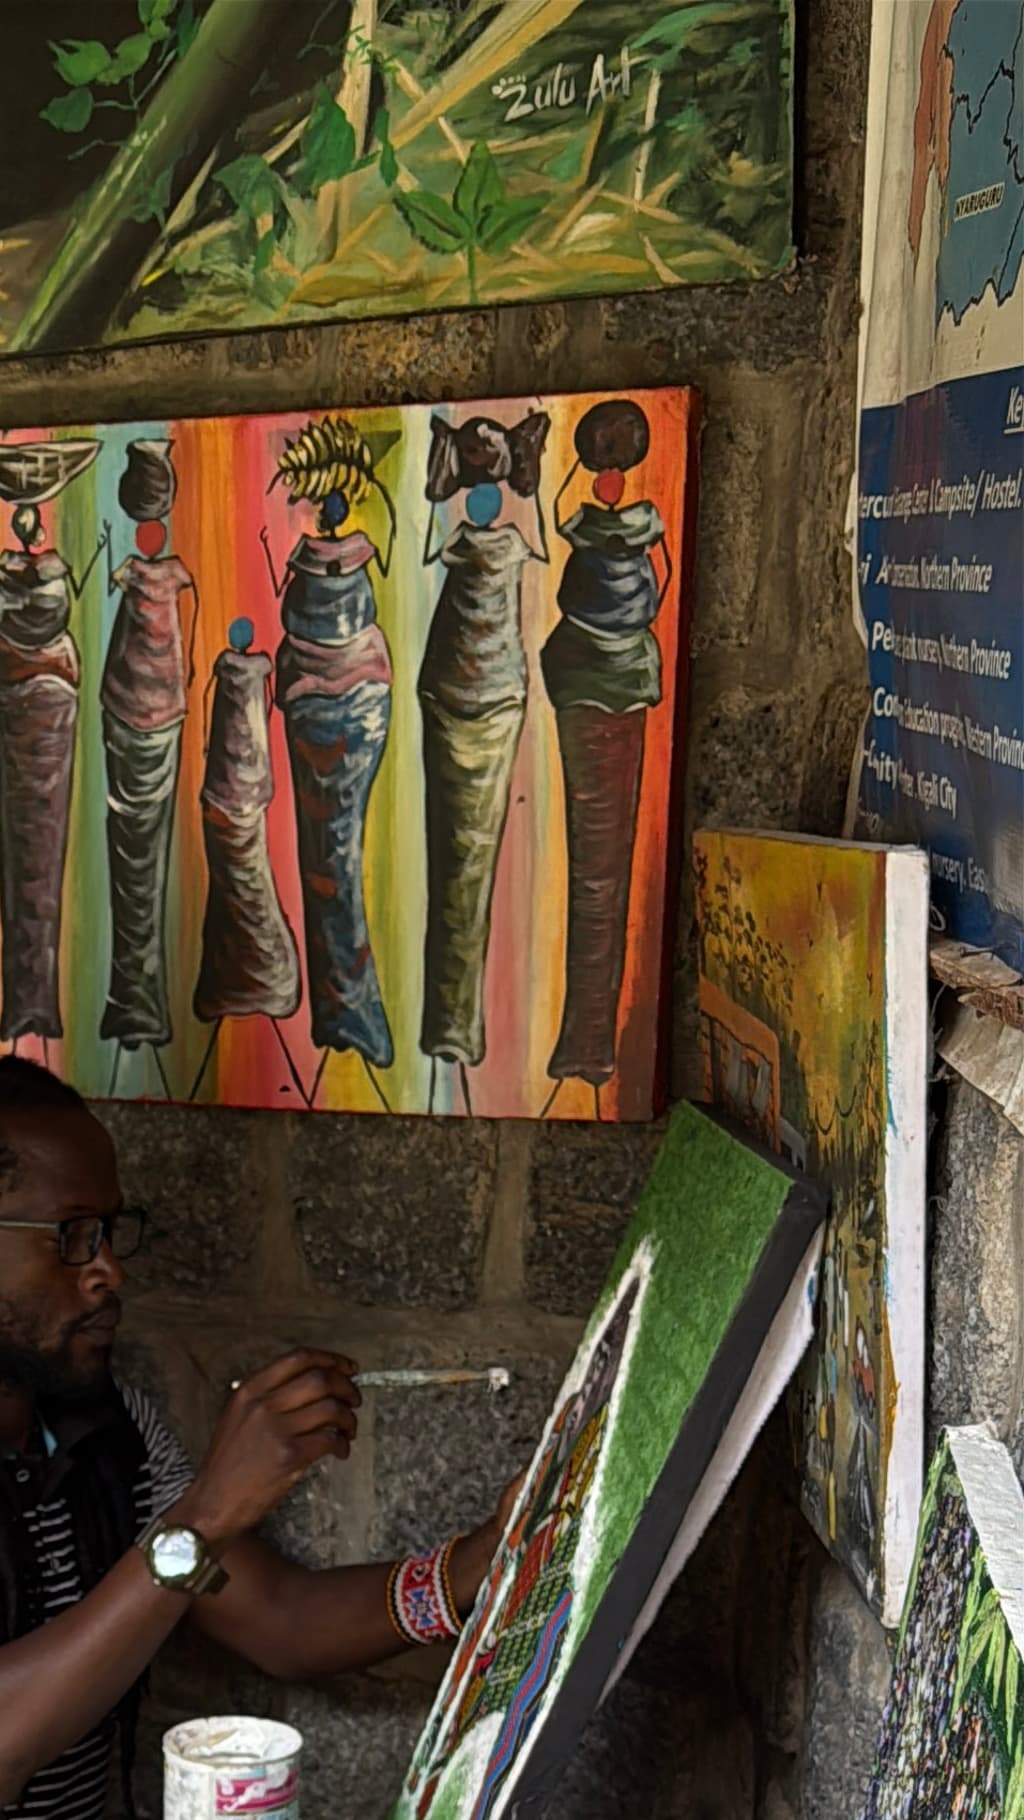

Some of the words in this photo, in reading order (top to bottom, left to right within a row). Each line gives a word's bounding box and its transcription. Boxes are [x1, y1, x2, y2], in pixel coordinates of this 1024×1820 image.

[494, 62, 576, 122] Zulu
[586, 46, 652, 116] Art
[1006, 385, 1024, 429] Ke
[950, 554, 993, 593] Province
[969, 637, 1012, 680] Province
[993, 724, 1024, 772] Provinc
